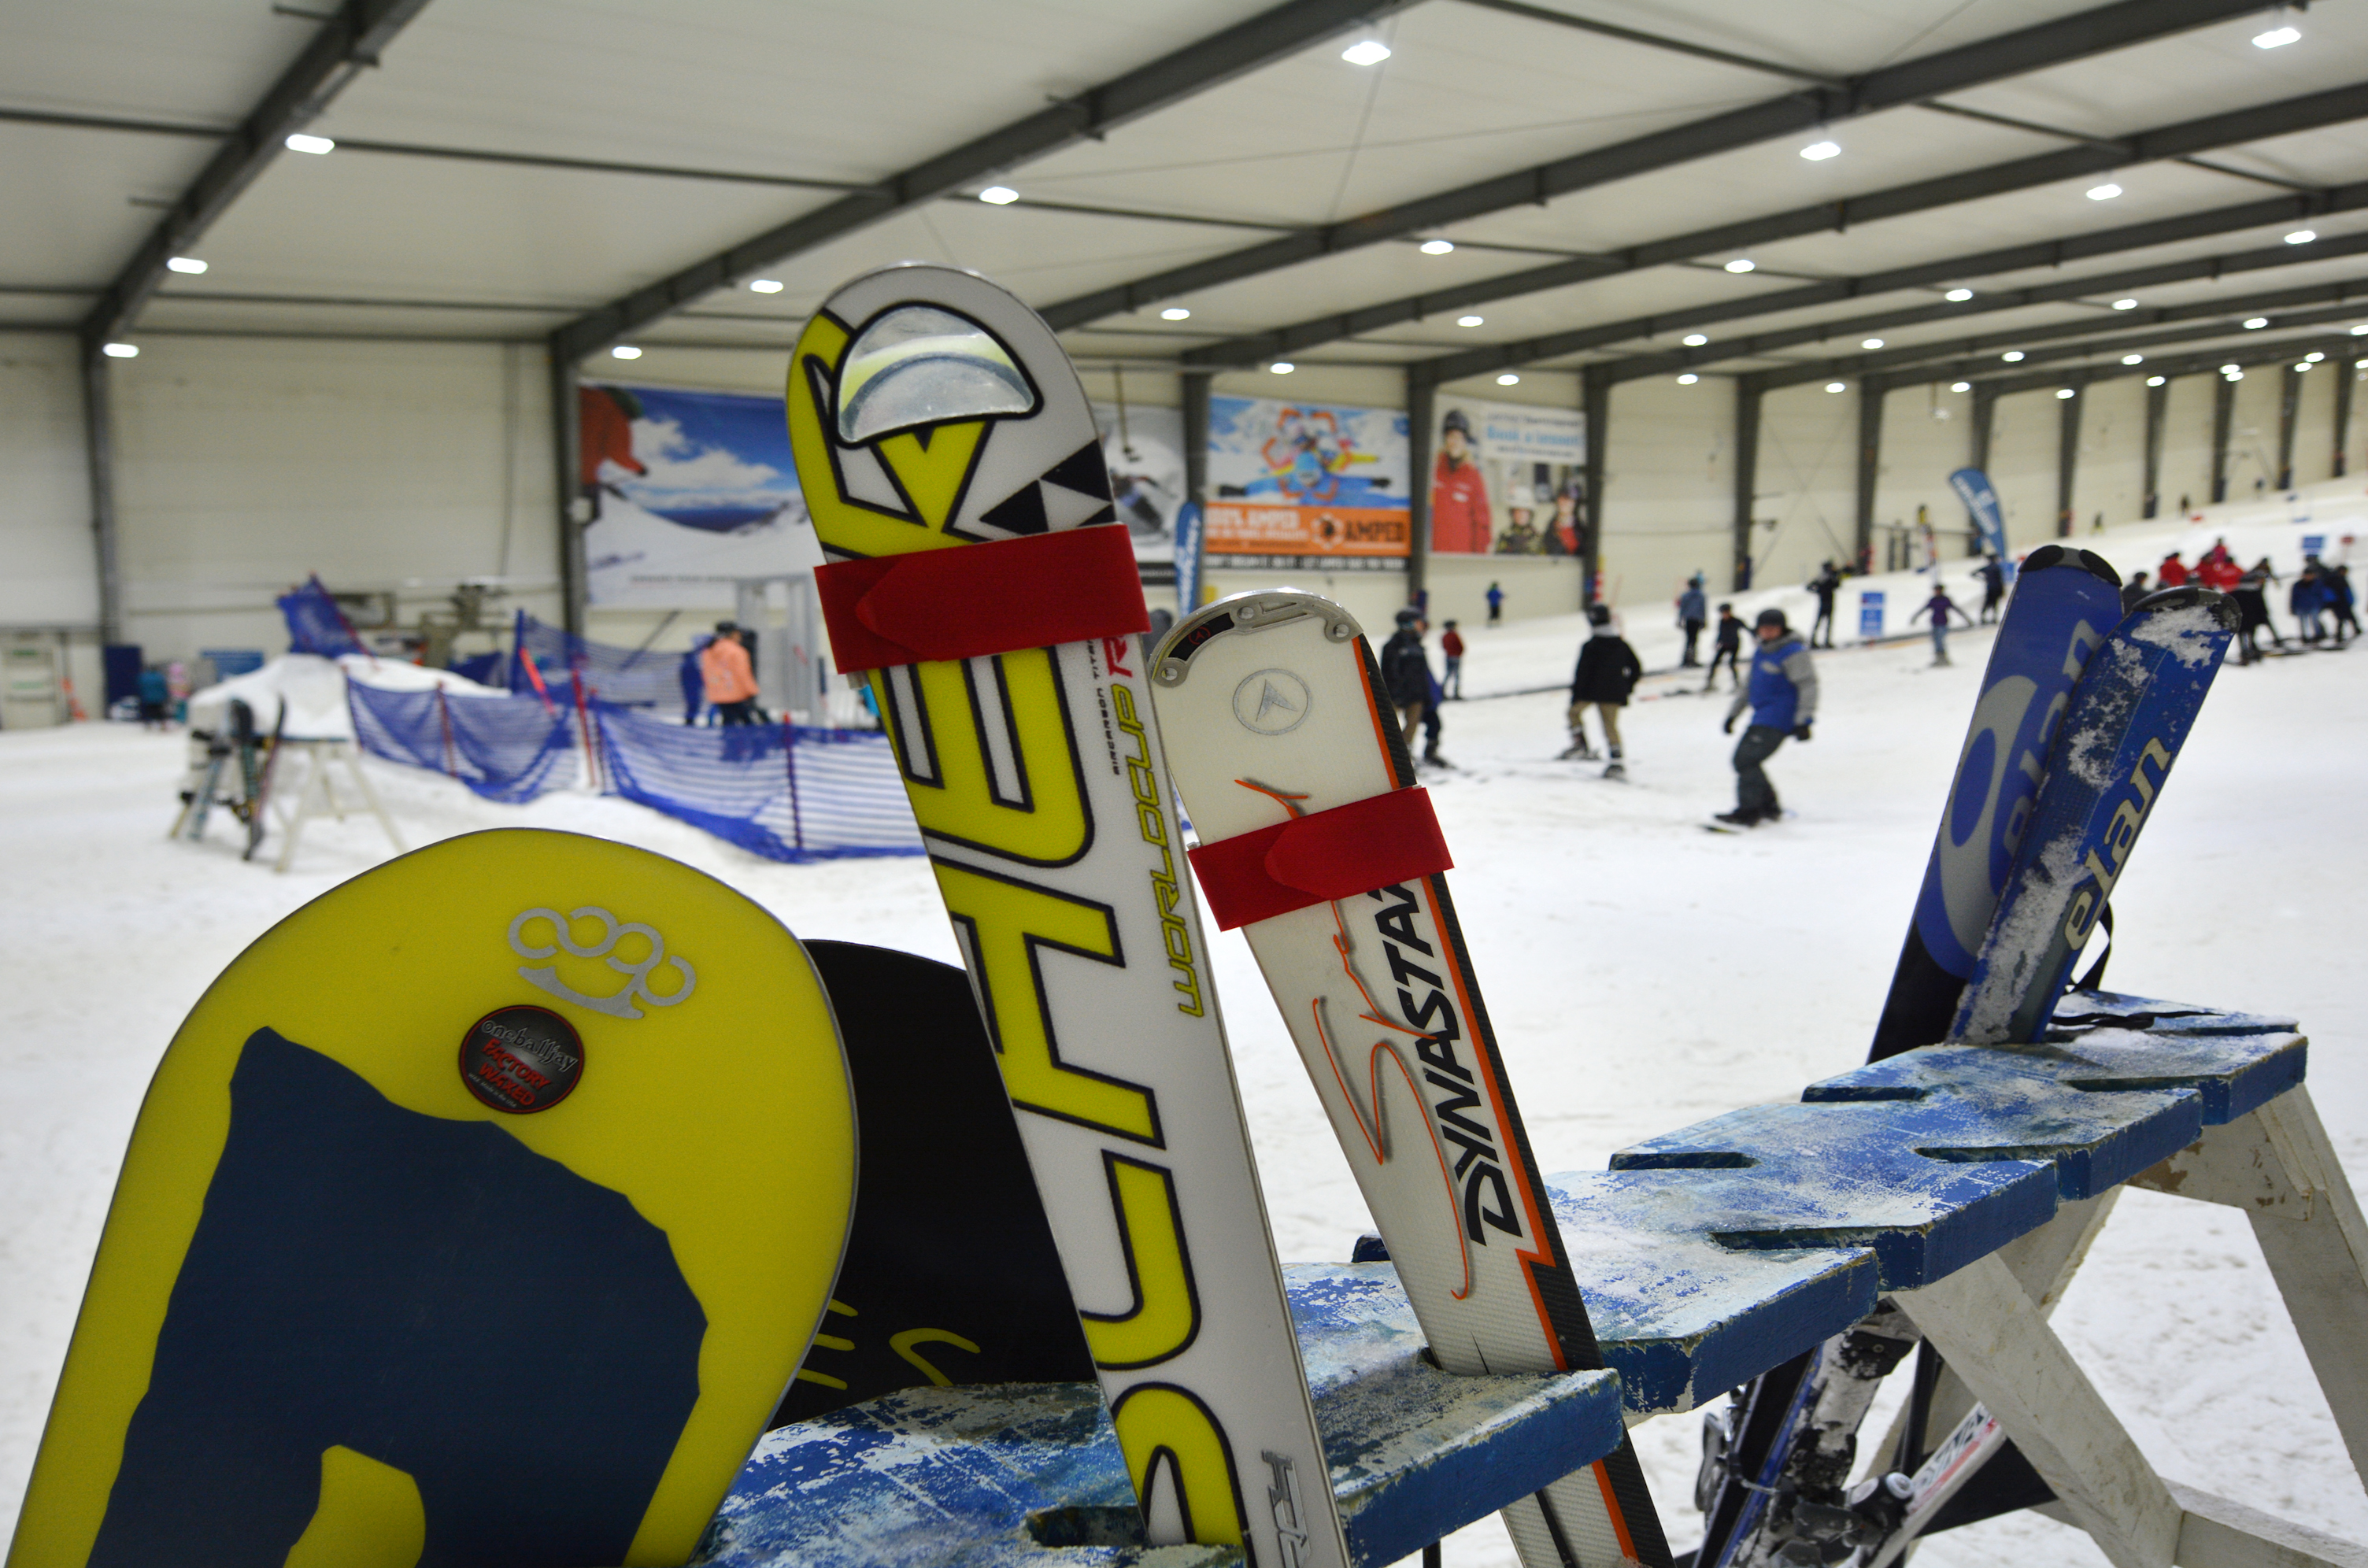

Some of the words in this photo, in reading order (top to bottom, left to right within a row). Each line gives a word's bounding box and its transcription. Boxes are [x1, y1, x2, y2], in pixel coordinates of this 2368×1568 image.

[1346, 520, 1404, 542] AMPED
[1112, 682, 1205, 1018] WORLDCUP
[2064, 736, 2173, 951] elan
[478, 1062, 536, 1107] WAXED
[481, 1037, 552, 1091] FACTORY
